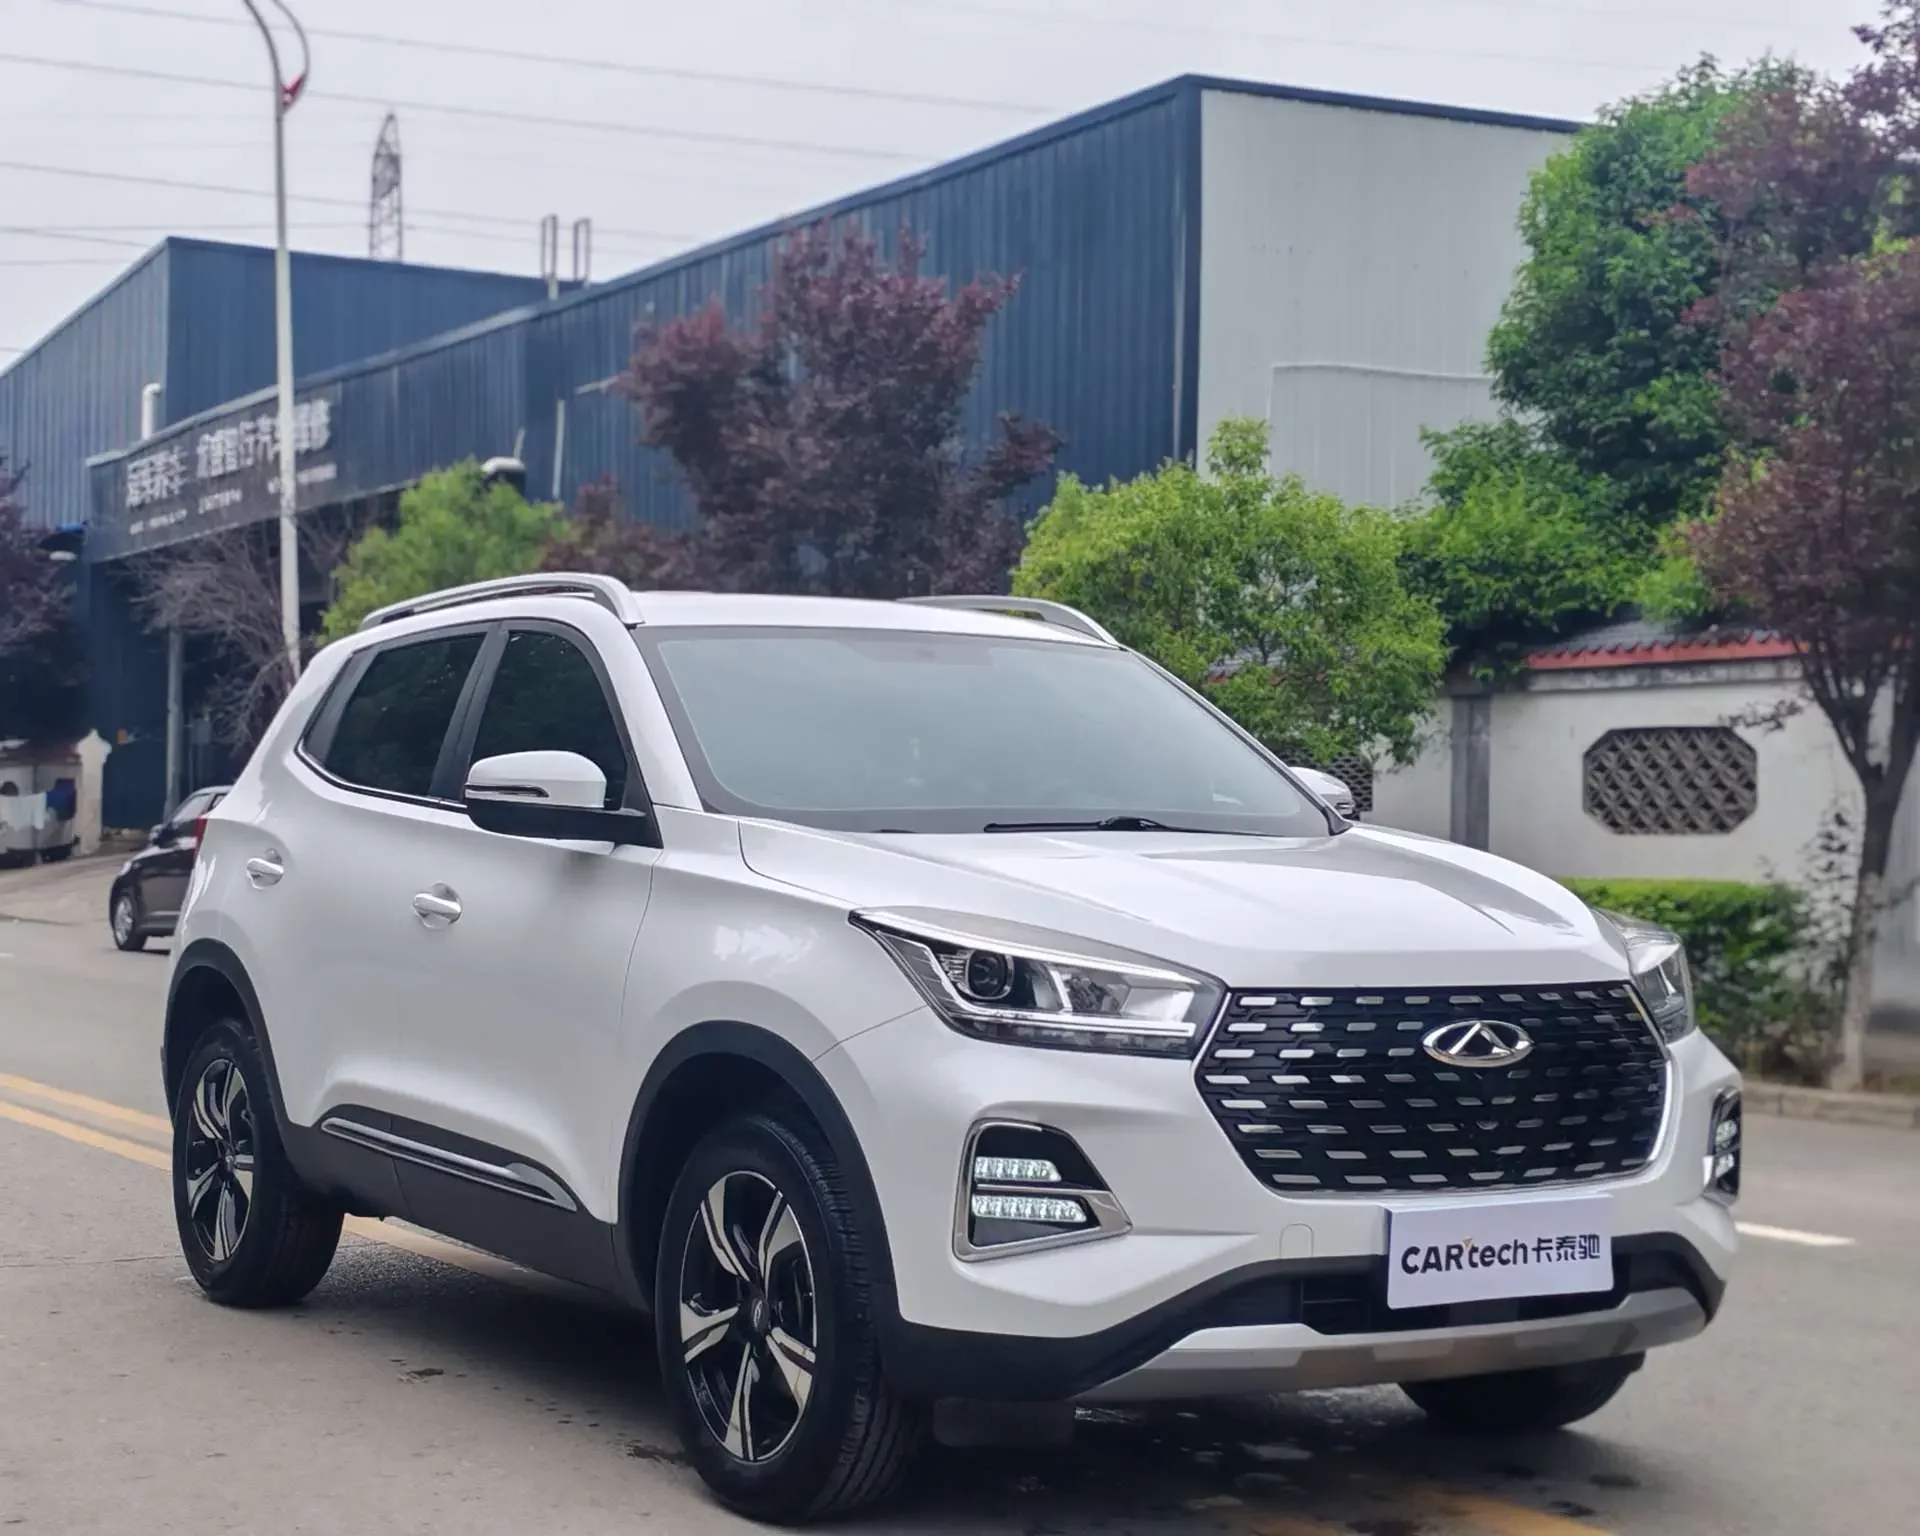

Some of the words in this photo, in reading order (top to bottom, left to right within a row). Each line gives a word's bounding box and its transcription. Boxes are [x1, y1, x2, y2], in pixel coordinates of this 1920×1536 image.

[1400, 1237, 1529, 1275] CARtech
[1530, 1232, 1602, 1264] 卡泰驰
